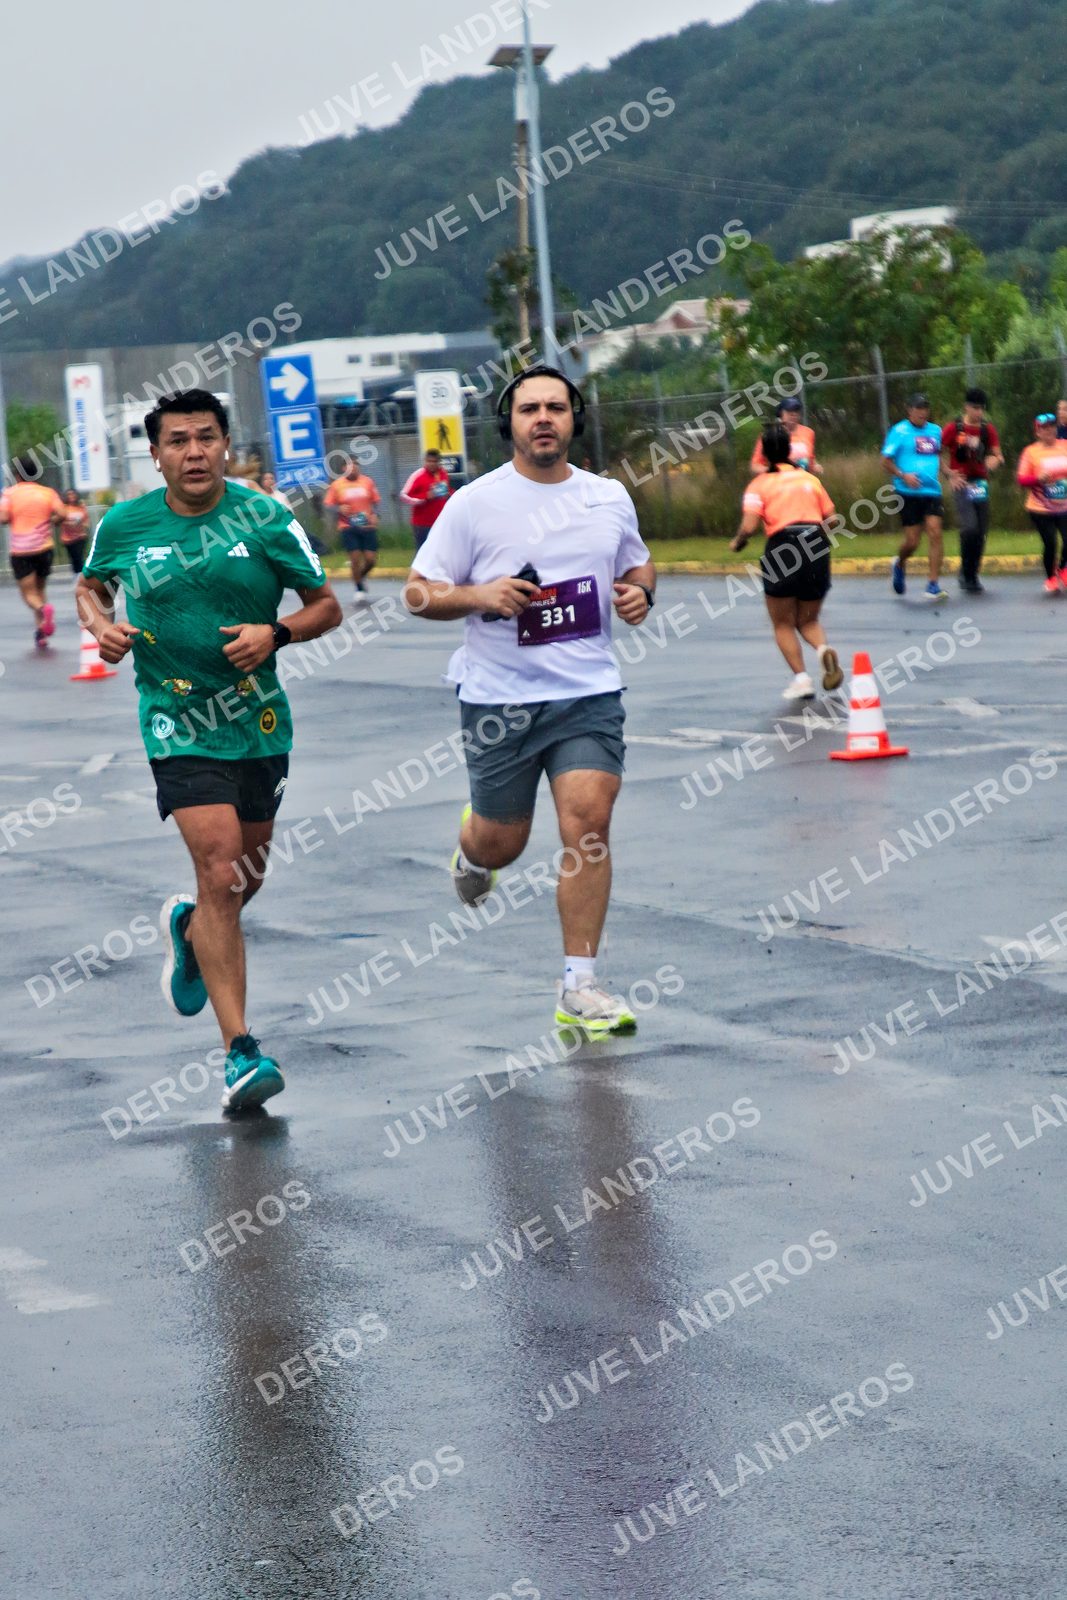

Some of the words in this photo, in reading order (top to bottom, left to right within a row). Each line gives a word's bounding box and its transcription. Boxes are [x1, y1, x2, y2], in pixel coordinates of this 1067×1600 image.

[278, 412, 317, 459] E
[577, 580, 592, 594] 15K
[541, 604, 576, 628] 331
